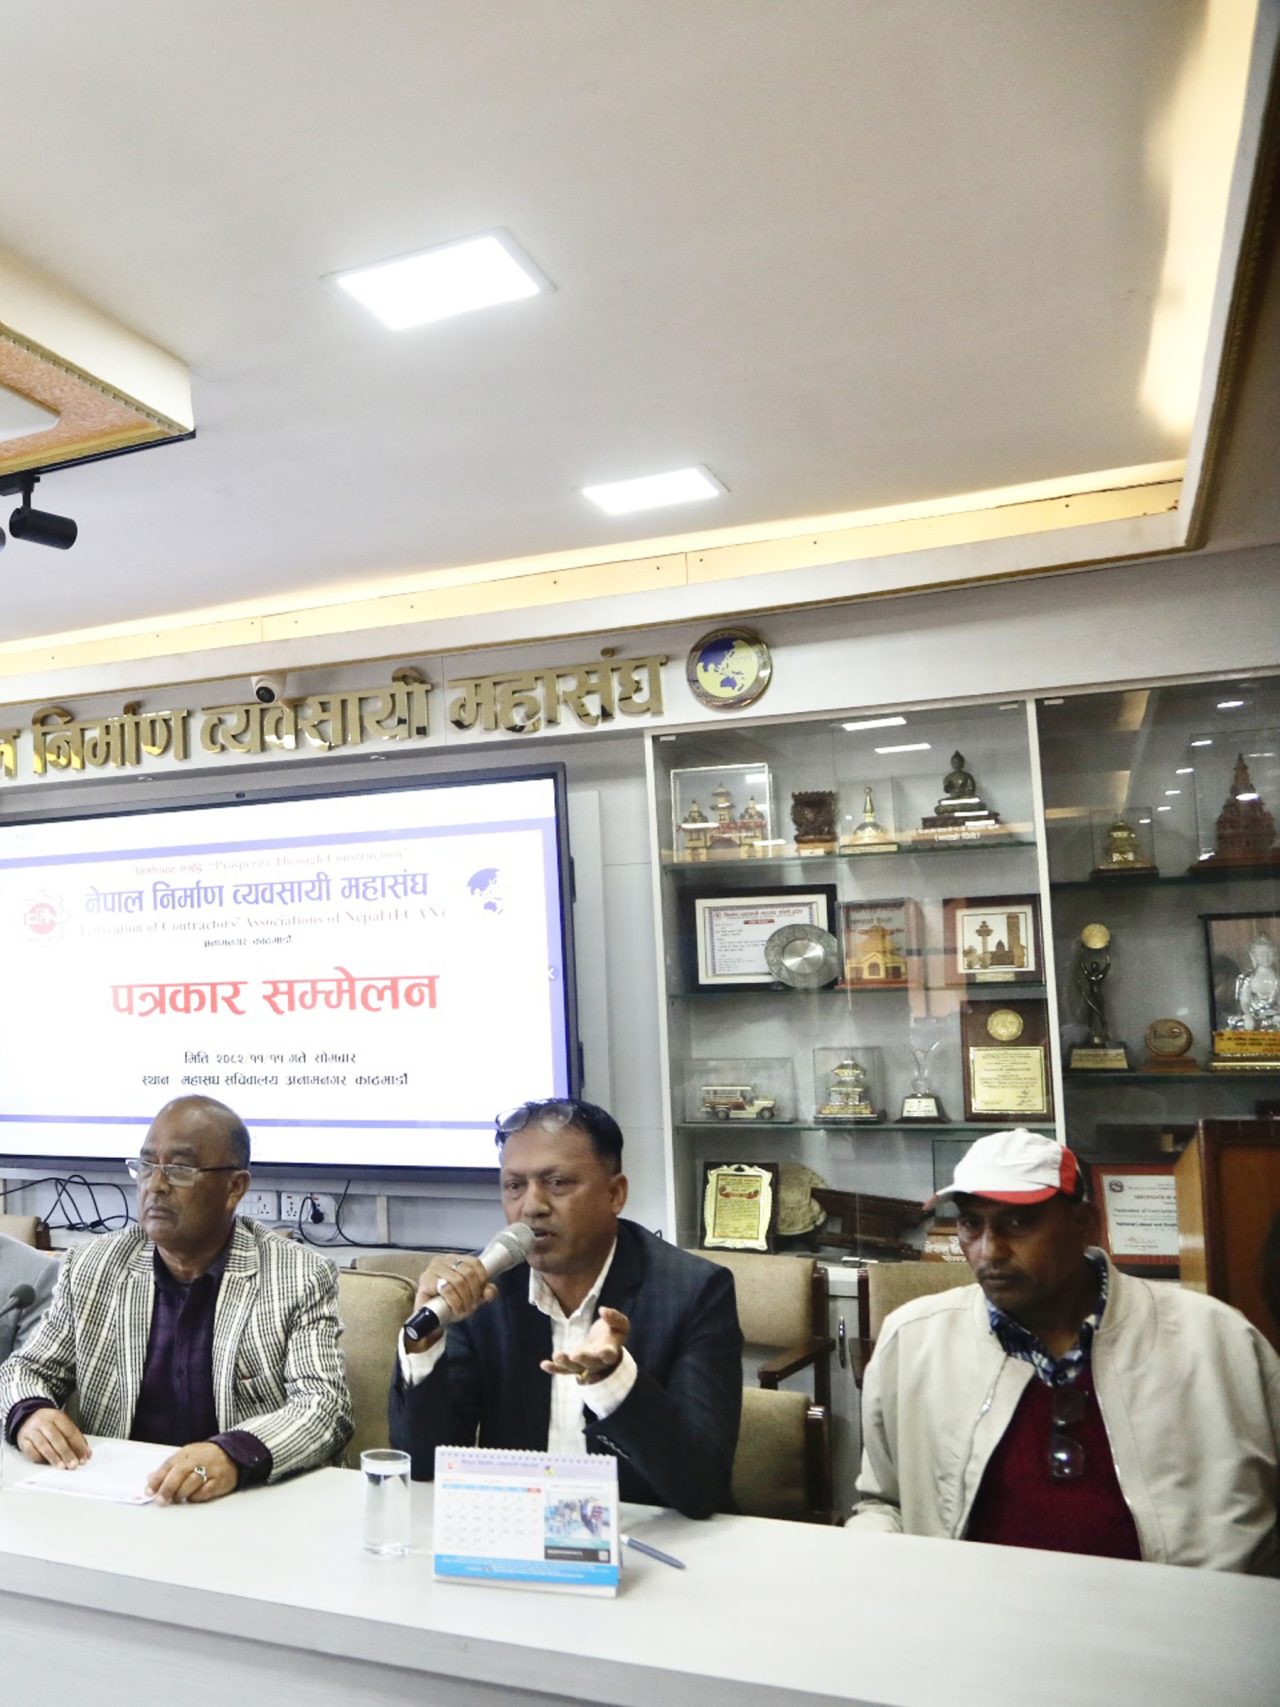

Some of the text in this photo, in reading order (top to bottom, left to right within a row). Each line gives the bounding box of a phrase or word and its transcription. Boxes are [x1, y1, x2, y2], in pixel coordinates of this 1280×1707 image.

[31, 702, 188, 776] निर्माण
[200, 666, 432, 753] व्यवसायी
[449, 647, 668, 734] महासंघ
[85, 886, 144, 914] नेपाल
[152, 880, 224, 910] निर्माण
[232, 872, 333, 906] व्यवसायी
[341, 869, 429, 902] महासंघ
[110, 966, 440, 1017] पत्रकार सम्मेलन
